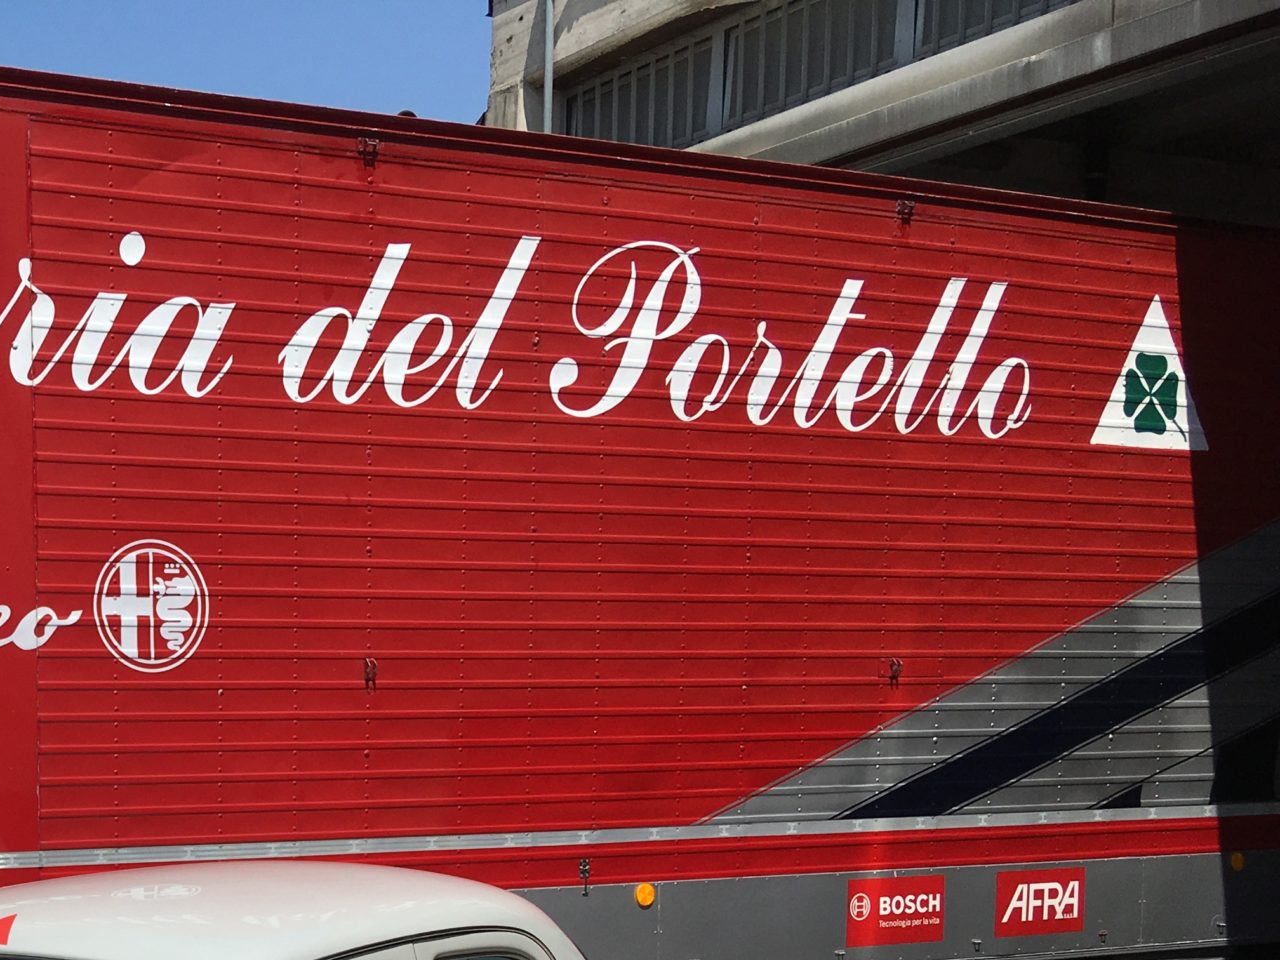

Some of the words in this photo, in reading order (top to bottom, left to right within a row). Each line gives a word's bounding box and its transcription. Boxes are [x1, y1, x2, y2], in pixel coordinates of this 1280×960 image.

[277, 234, 543, 409] del
[549, 239, 1033, 440] Portello
[879, 893, 940, 916] BOSCH
[1001, 880, 1079, 923] AFRA
[879, 918, 911, 928] Tecnologia
[912, 918, 922, 927] per
[922, 917, 929, 925] la
[929, 916, 940, 925] vita
